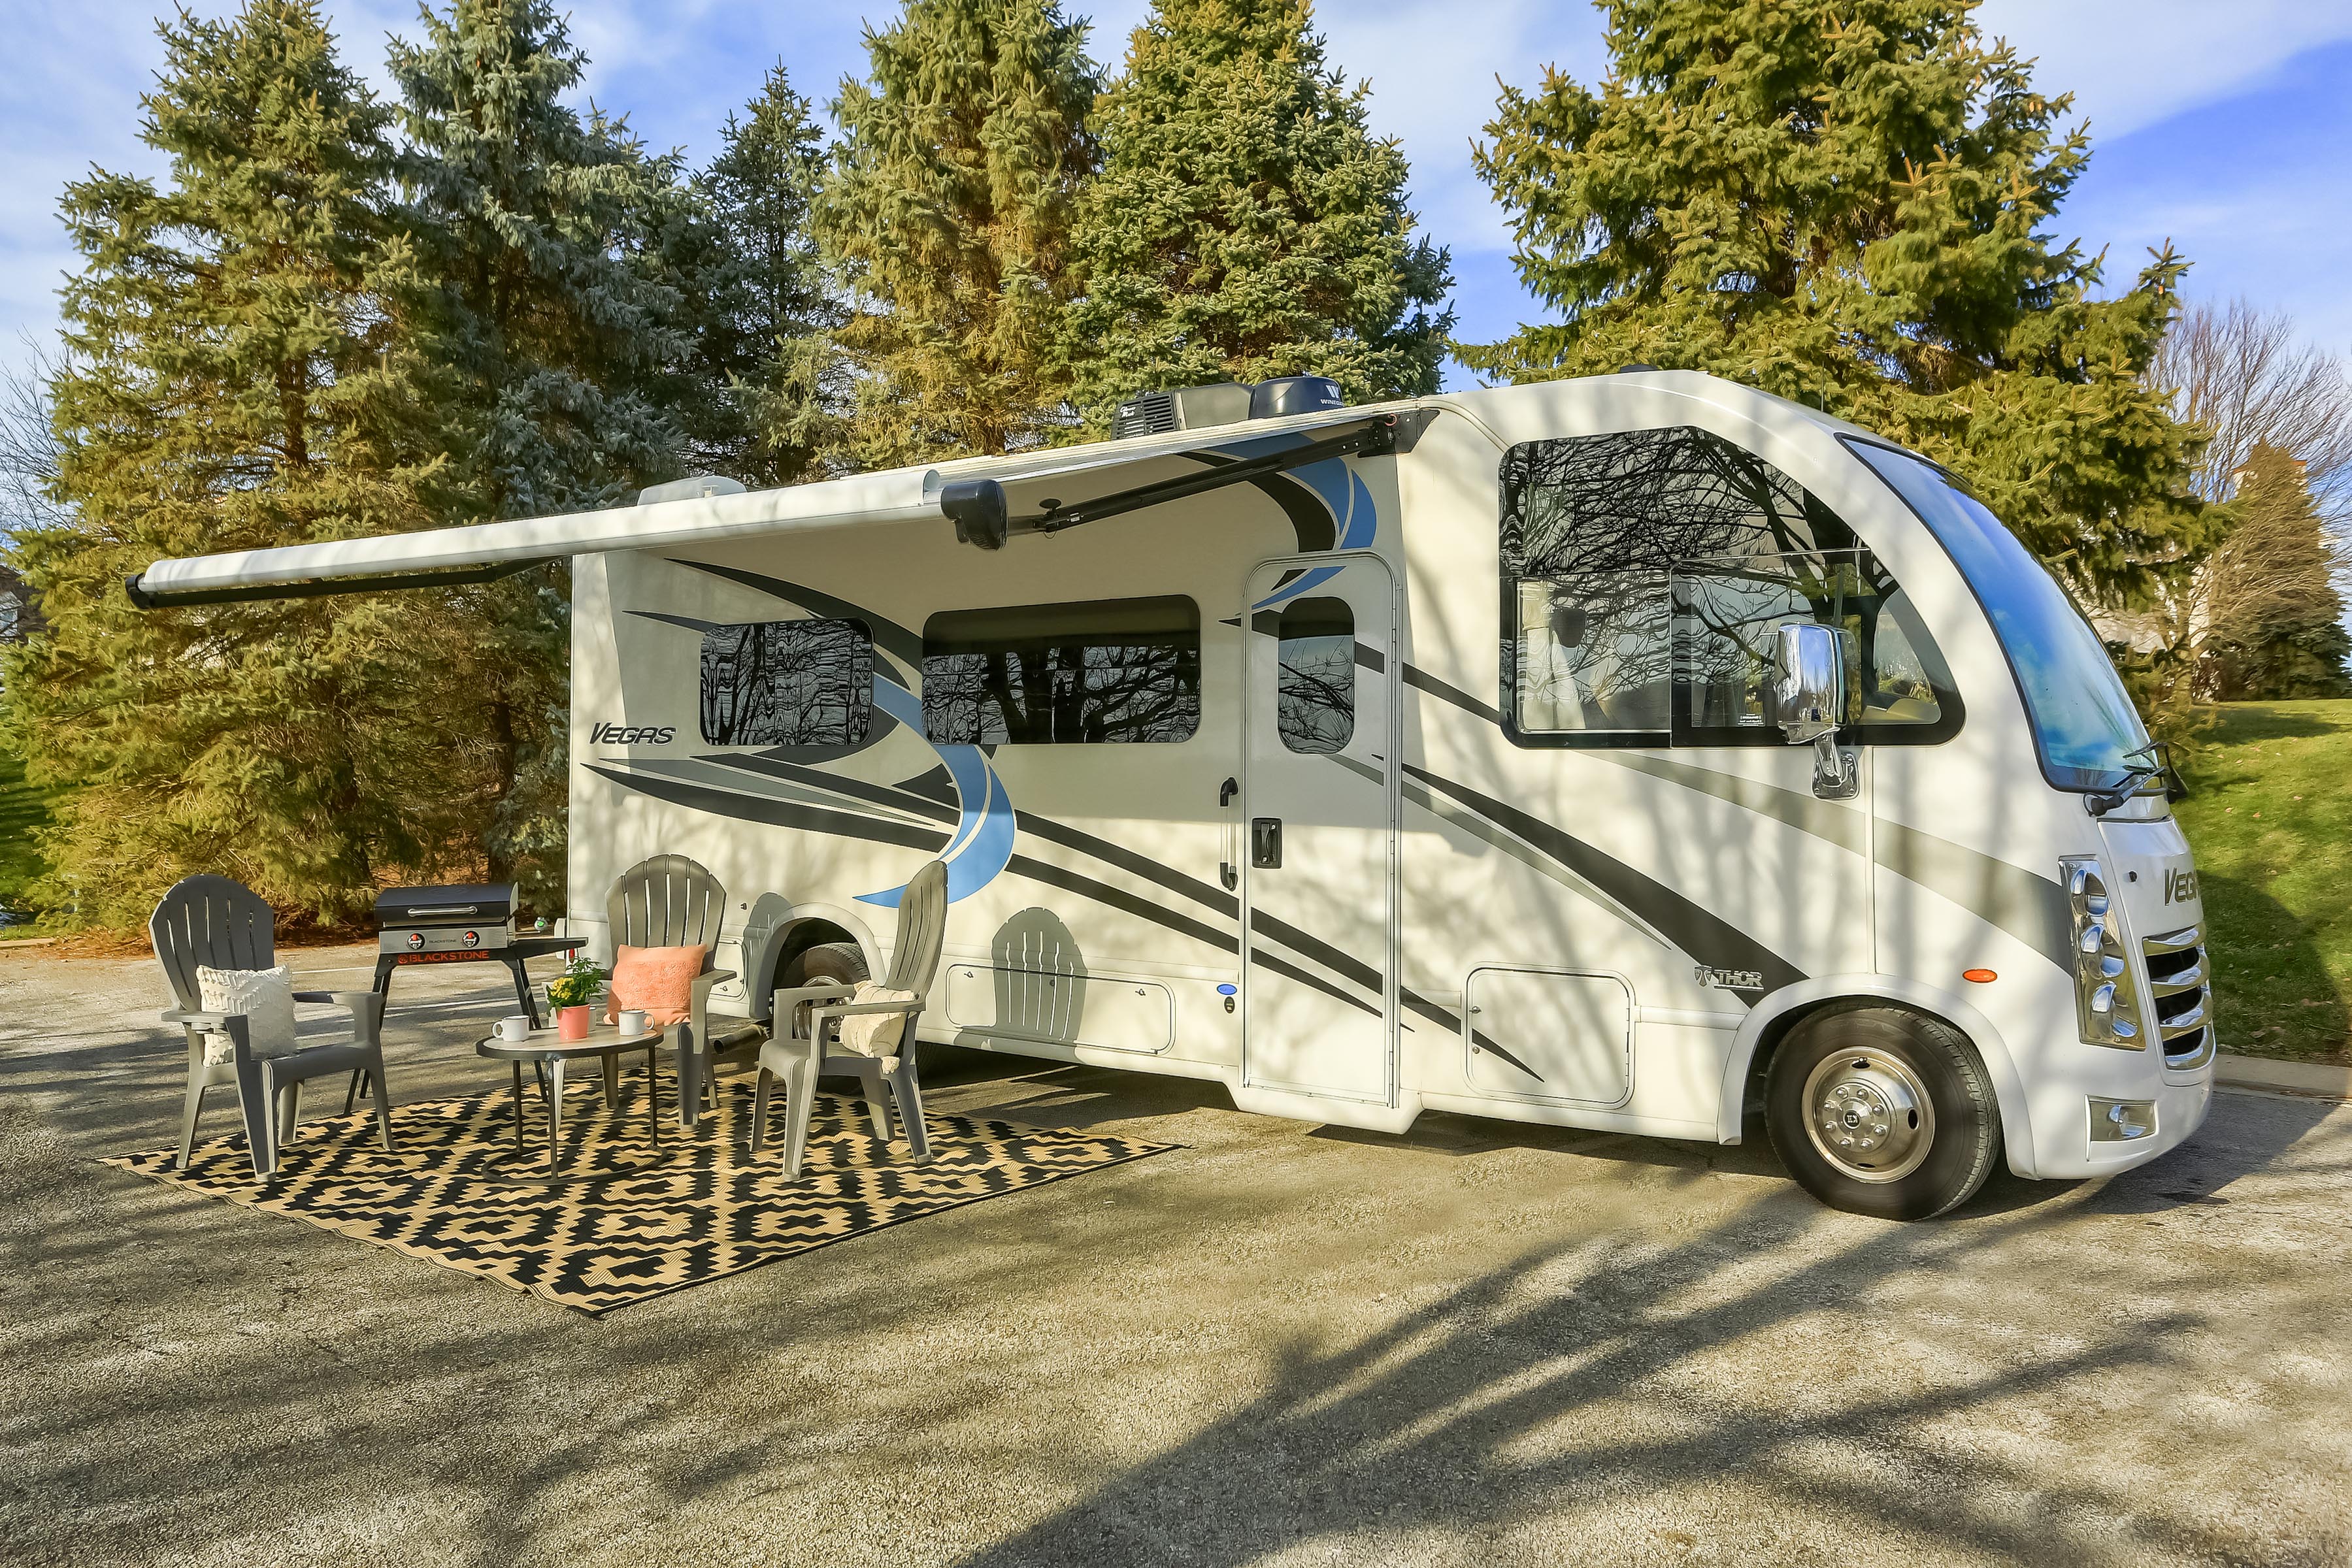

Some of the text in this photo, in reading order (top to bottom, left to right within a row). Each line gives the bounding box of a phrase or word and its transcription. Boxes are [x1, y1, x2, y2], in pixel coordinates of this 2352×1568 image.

[589, 722, 676, 744] VEGAS
[409, 951, 490, 962] BLACKSTONE
[1714, 969, 1764, 987] THOR
